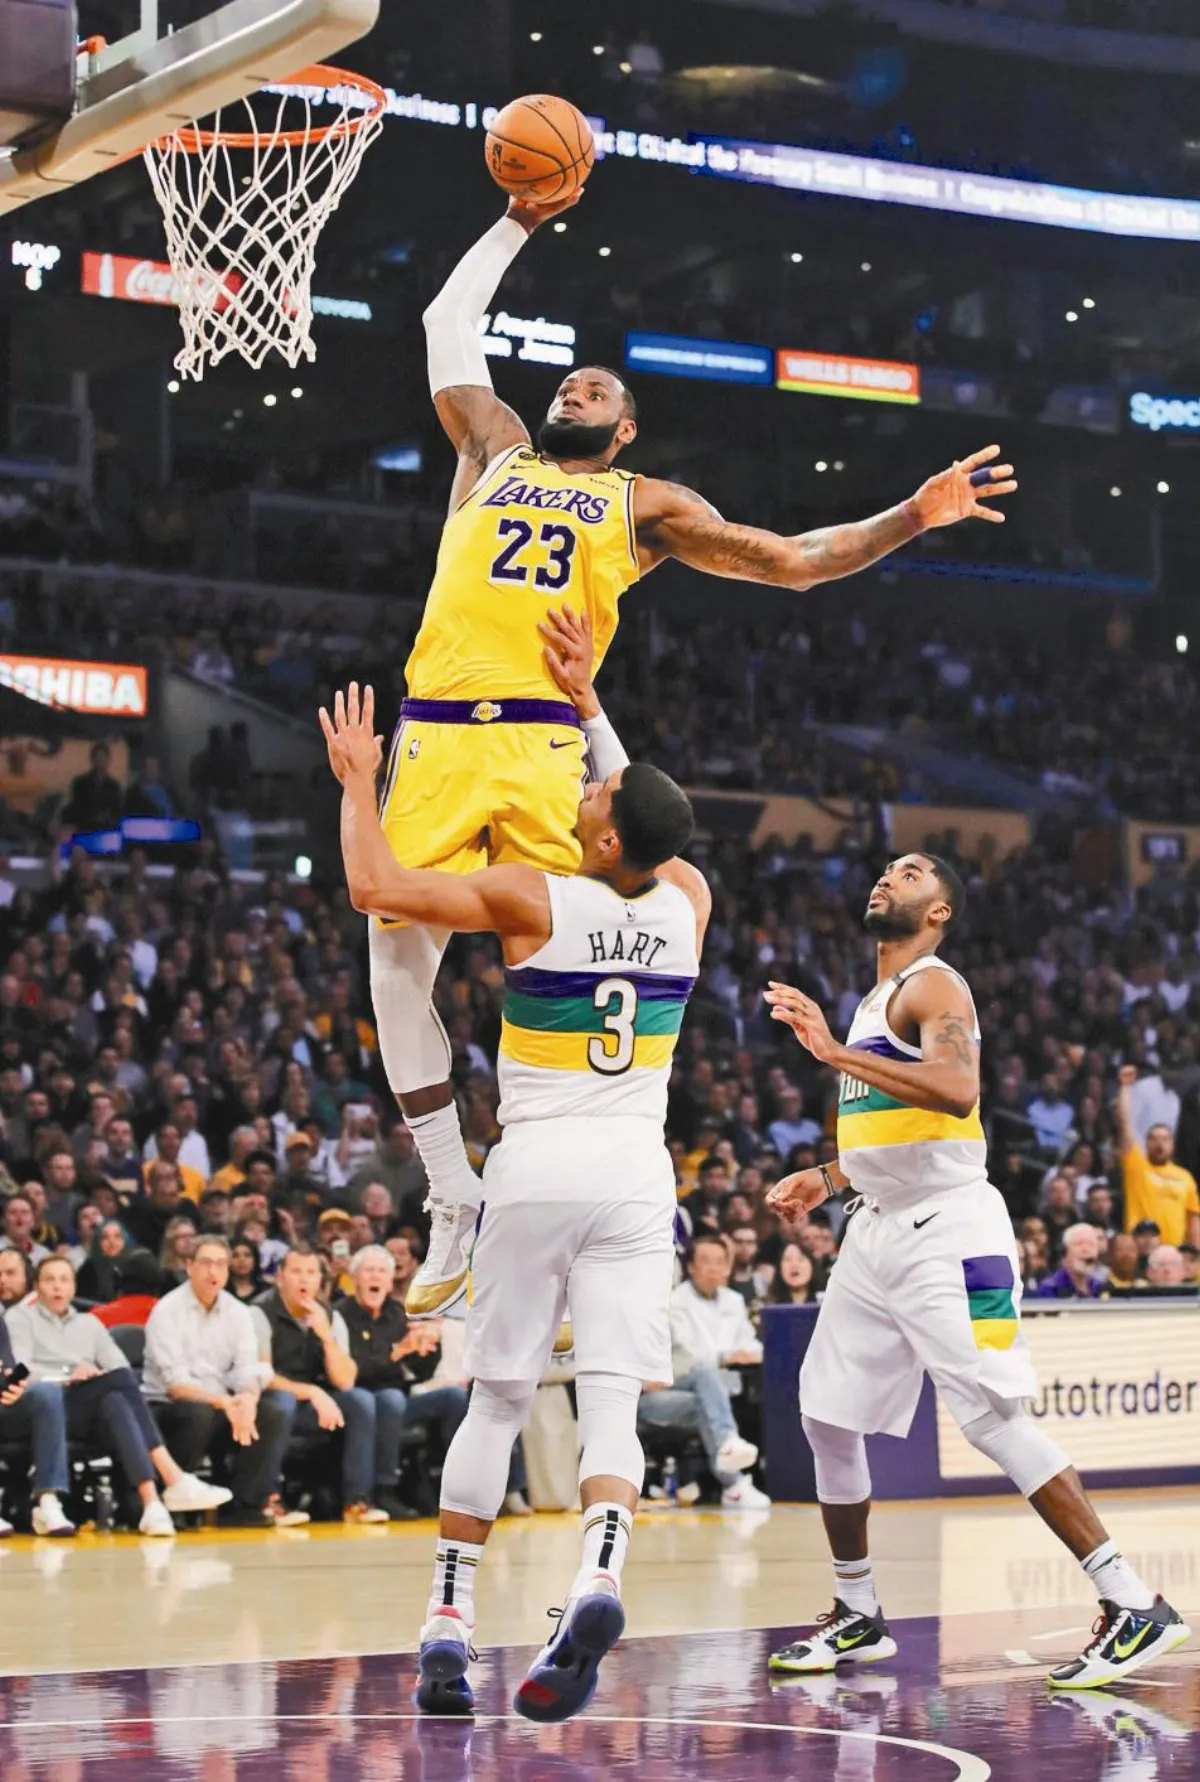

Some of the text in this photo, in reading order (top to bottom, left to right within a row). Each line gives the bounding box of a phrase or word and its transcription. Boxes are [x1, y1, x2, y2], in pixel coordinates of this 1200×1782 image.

[480, 475, 610, 524] LAKERS
[489, 517, 577, 592] 23
[587, 929, 668, 967] HART
[587, 976, 638, 1076] 3
[1030, 1369, 1197, 1418] utotrader
